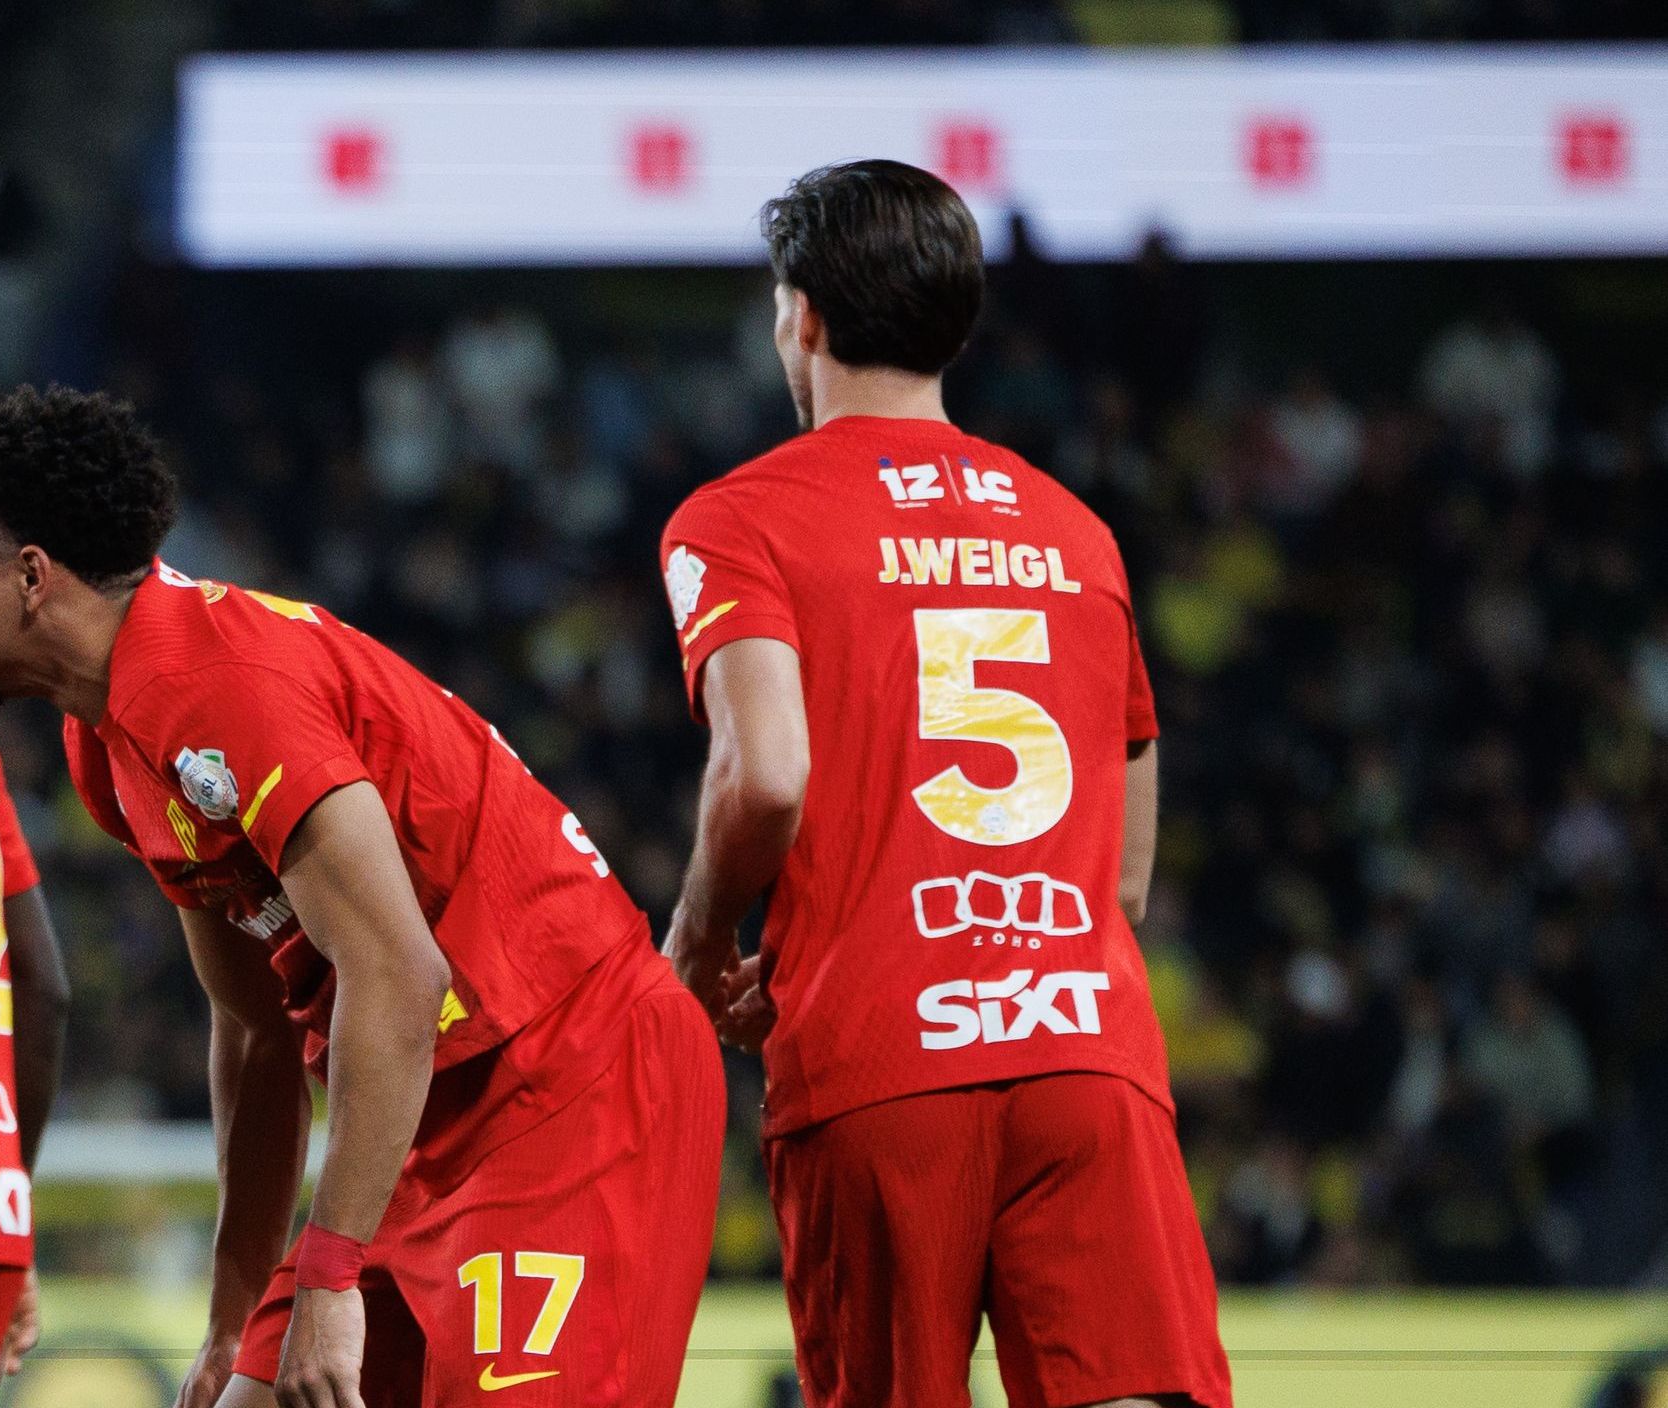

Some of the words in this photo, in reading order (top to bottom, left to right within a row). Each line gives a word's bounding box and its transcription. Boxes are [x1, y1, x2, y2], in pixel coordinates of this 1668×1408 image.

[878, 536, 1082, 594] J.WEIGL
[911, 608, 1074, 846] 5
[972, 931, 1042, 950] ZOHO
[457, 1251, 586, 1356] 17
